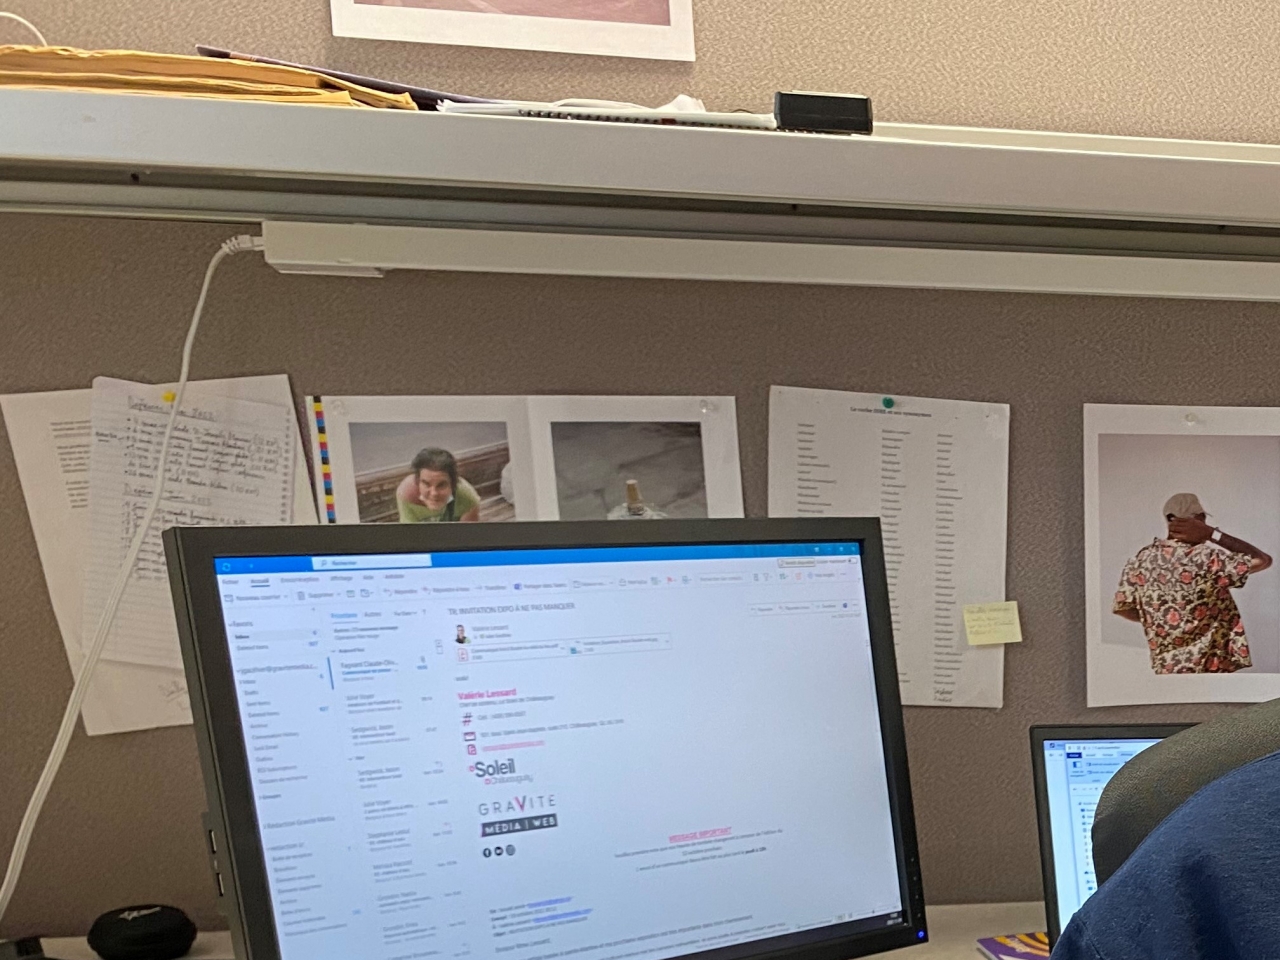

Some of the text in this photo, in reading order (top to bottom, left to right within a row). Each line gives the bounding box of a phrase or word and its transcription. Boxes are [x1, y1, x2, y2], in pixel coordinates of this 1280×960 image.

[459, 605, 497, 615] INVITATION
[474, 757, 517, 778] Soleil
[532, 816, 556, 827] WEB
